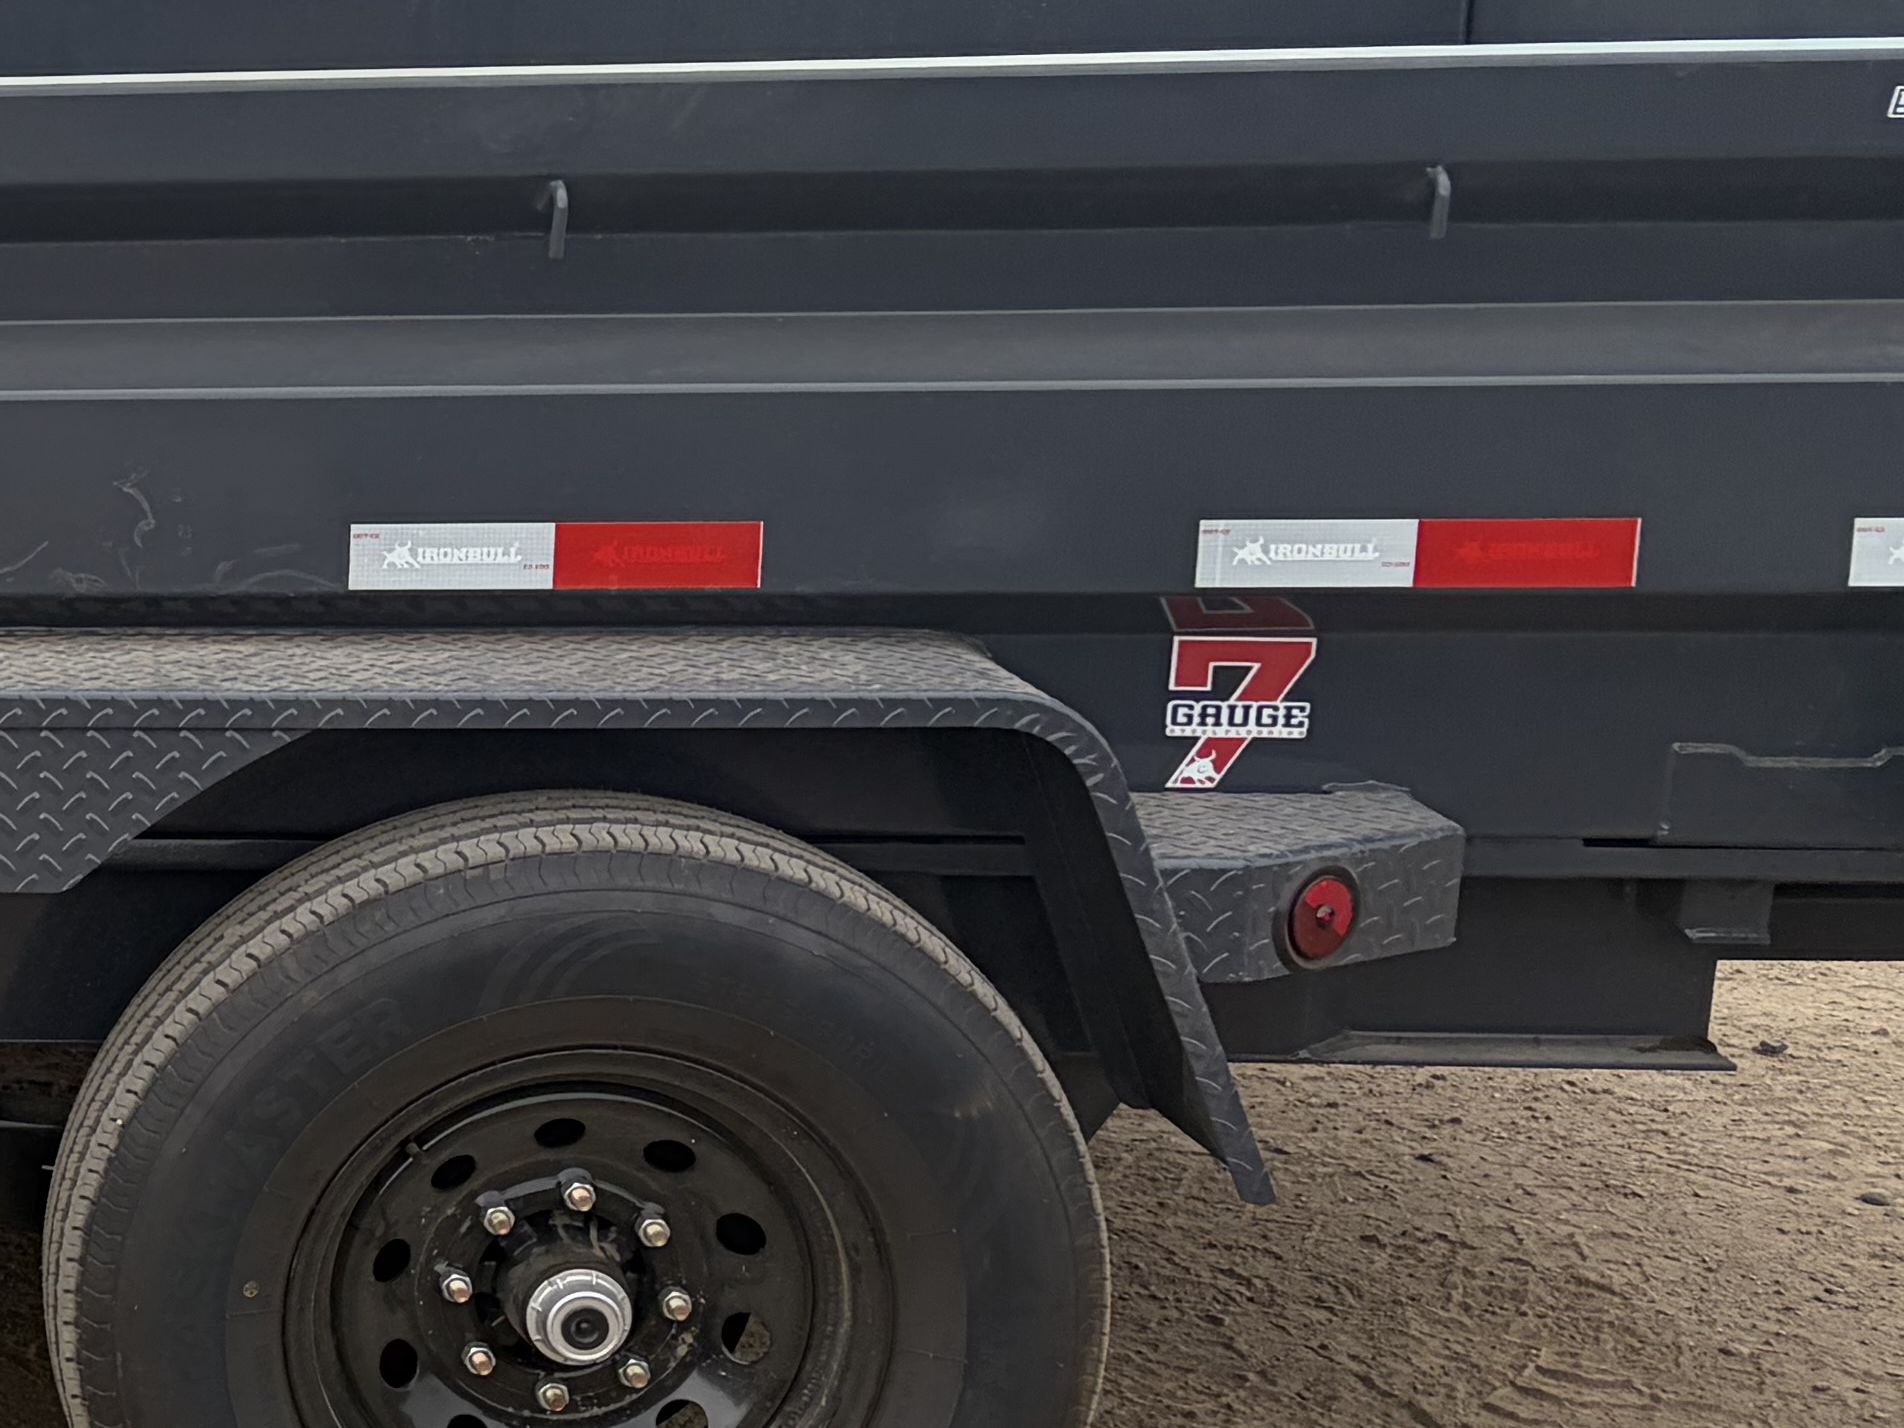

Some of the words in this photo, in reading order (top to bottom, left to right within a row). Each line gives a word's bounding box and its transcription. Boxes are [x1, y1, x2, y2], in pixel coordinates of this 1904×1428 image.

[416, 545, 523, 564] IRONBULL
[1268, 541, 1380, 561] IRONBULL
[1165, 636, 1317, 789] 7
[1169, 702, 1309, 728] GAUGE
